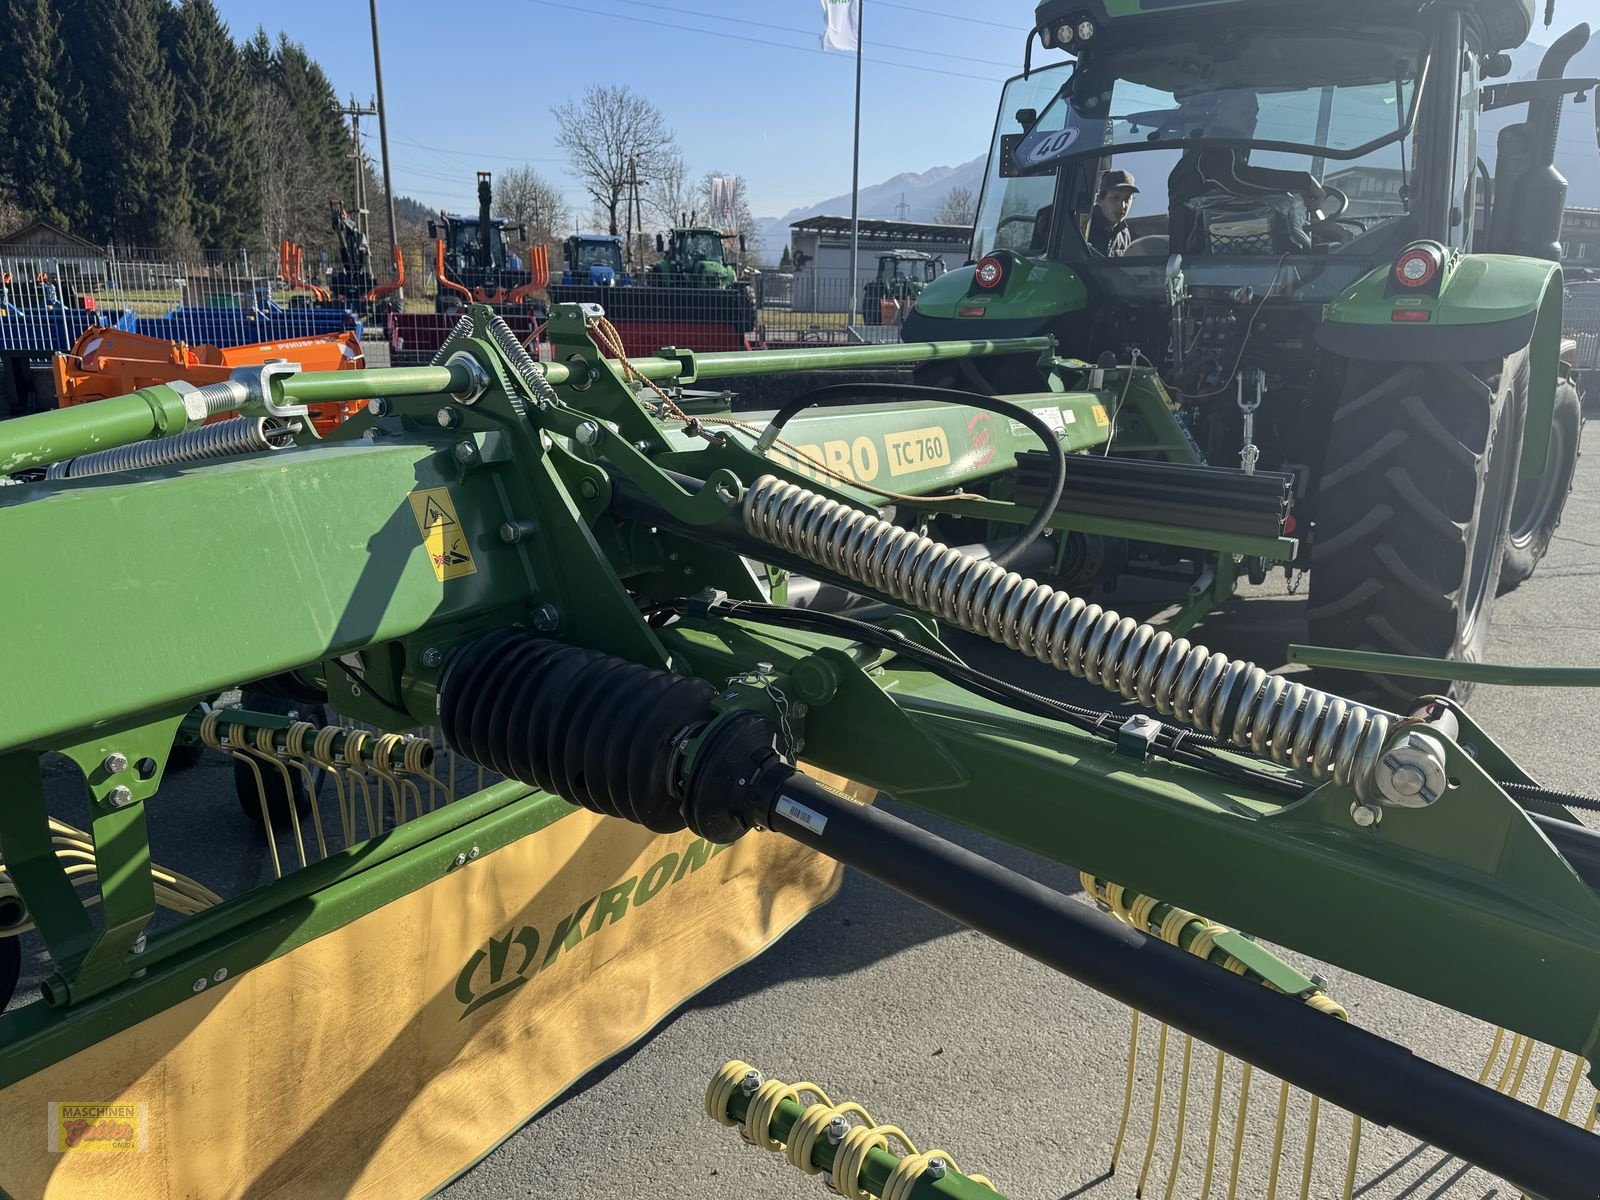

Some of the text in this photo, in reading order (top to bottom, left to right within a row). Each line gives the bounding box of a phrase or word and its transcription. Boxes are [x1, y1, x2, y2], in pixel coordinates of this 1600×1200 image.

[1036, 132, 1071, 156] 40
[892, 443, 914, 466] TC
[916, 436, 943, 462] 760
[540, 838, 735, 973] KRON
